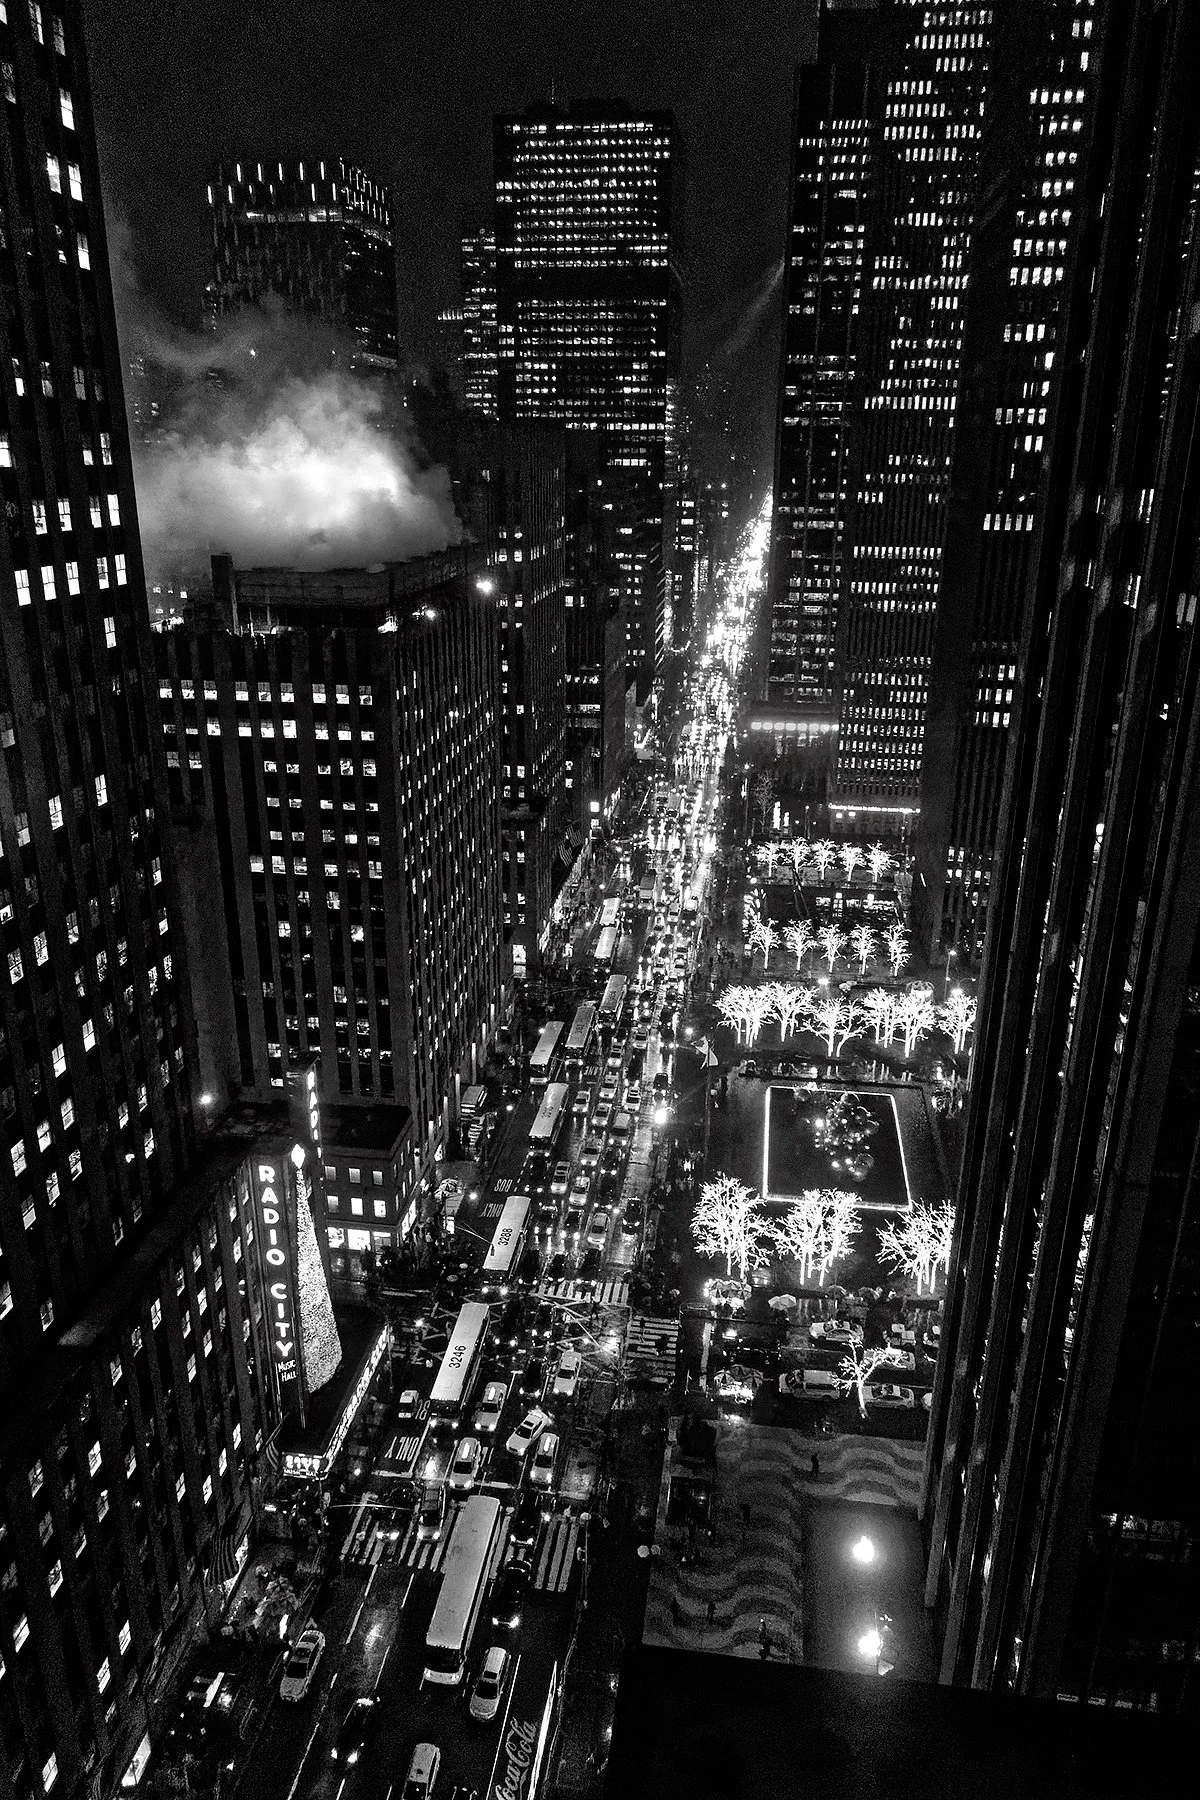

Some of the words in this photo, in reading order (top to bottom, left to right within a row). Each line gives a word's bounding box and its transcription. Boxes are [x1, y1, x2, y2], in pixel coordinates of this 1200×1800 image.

[494, 1178, 513, 1192] BUS
[258, 1165, 285, 1266] RADIO
[480, 1203, 504, 1217] ONLY
[270, 1283, 293, 1357] CITY
[277, 1359, 296, 1373] MUSIC
[448, 1345, 467, 1369] 3246
[281, 1370, 297, 1382] HALL
[384, 1436, 420, 1462] ONLY
